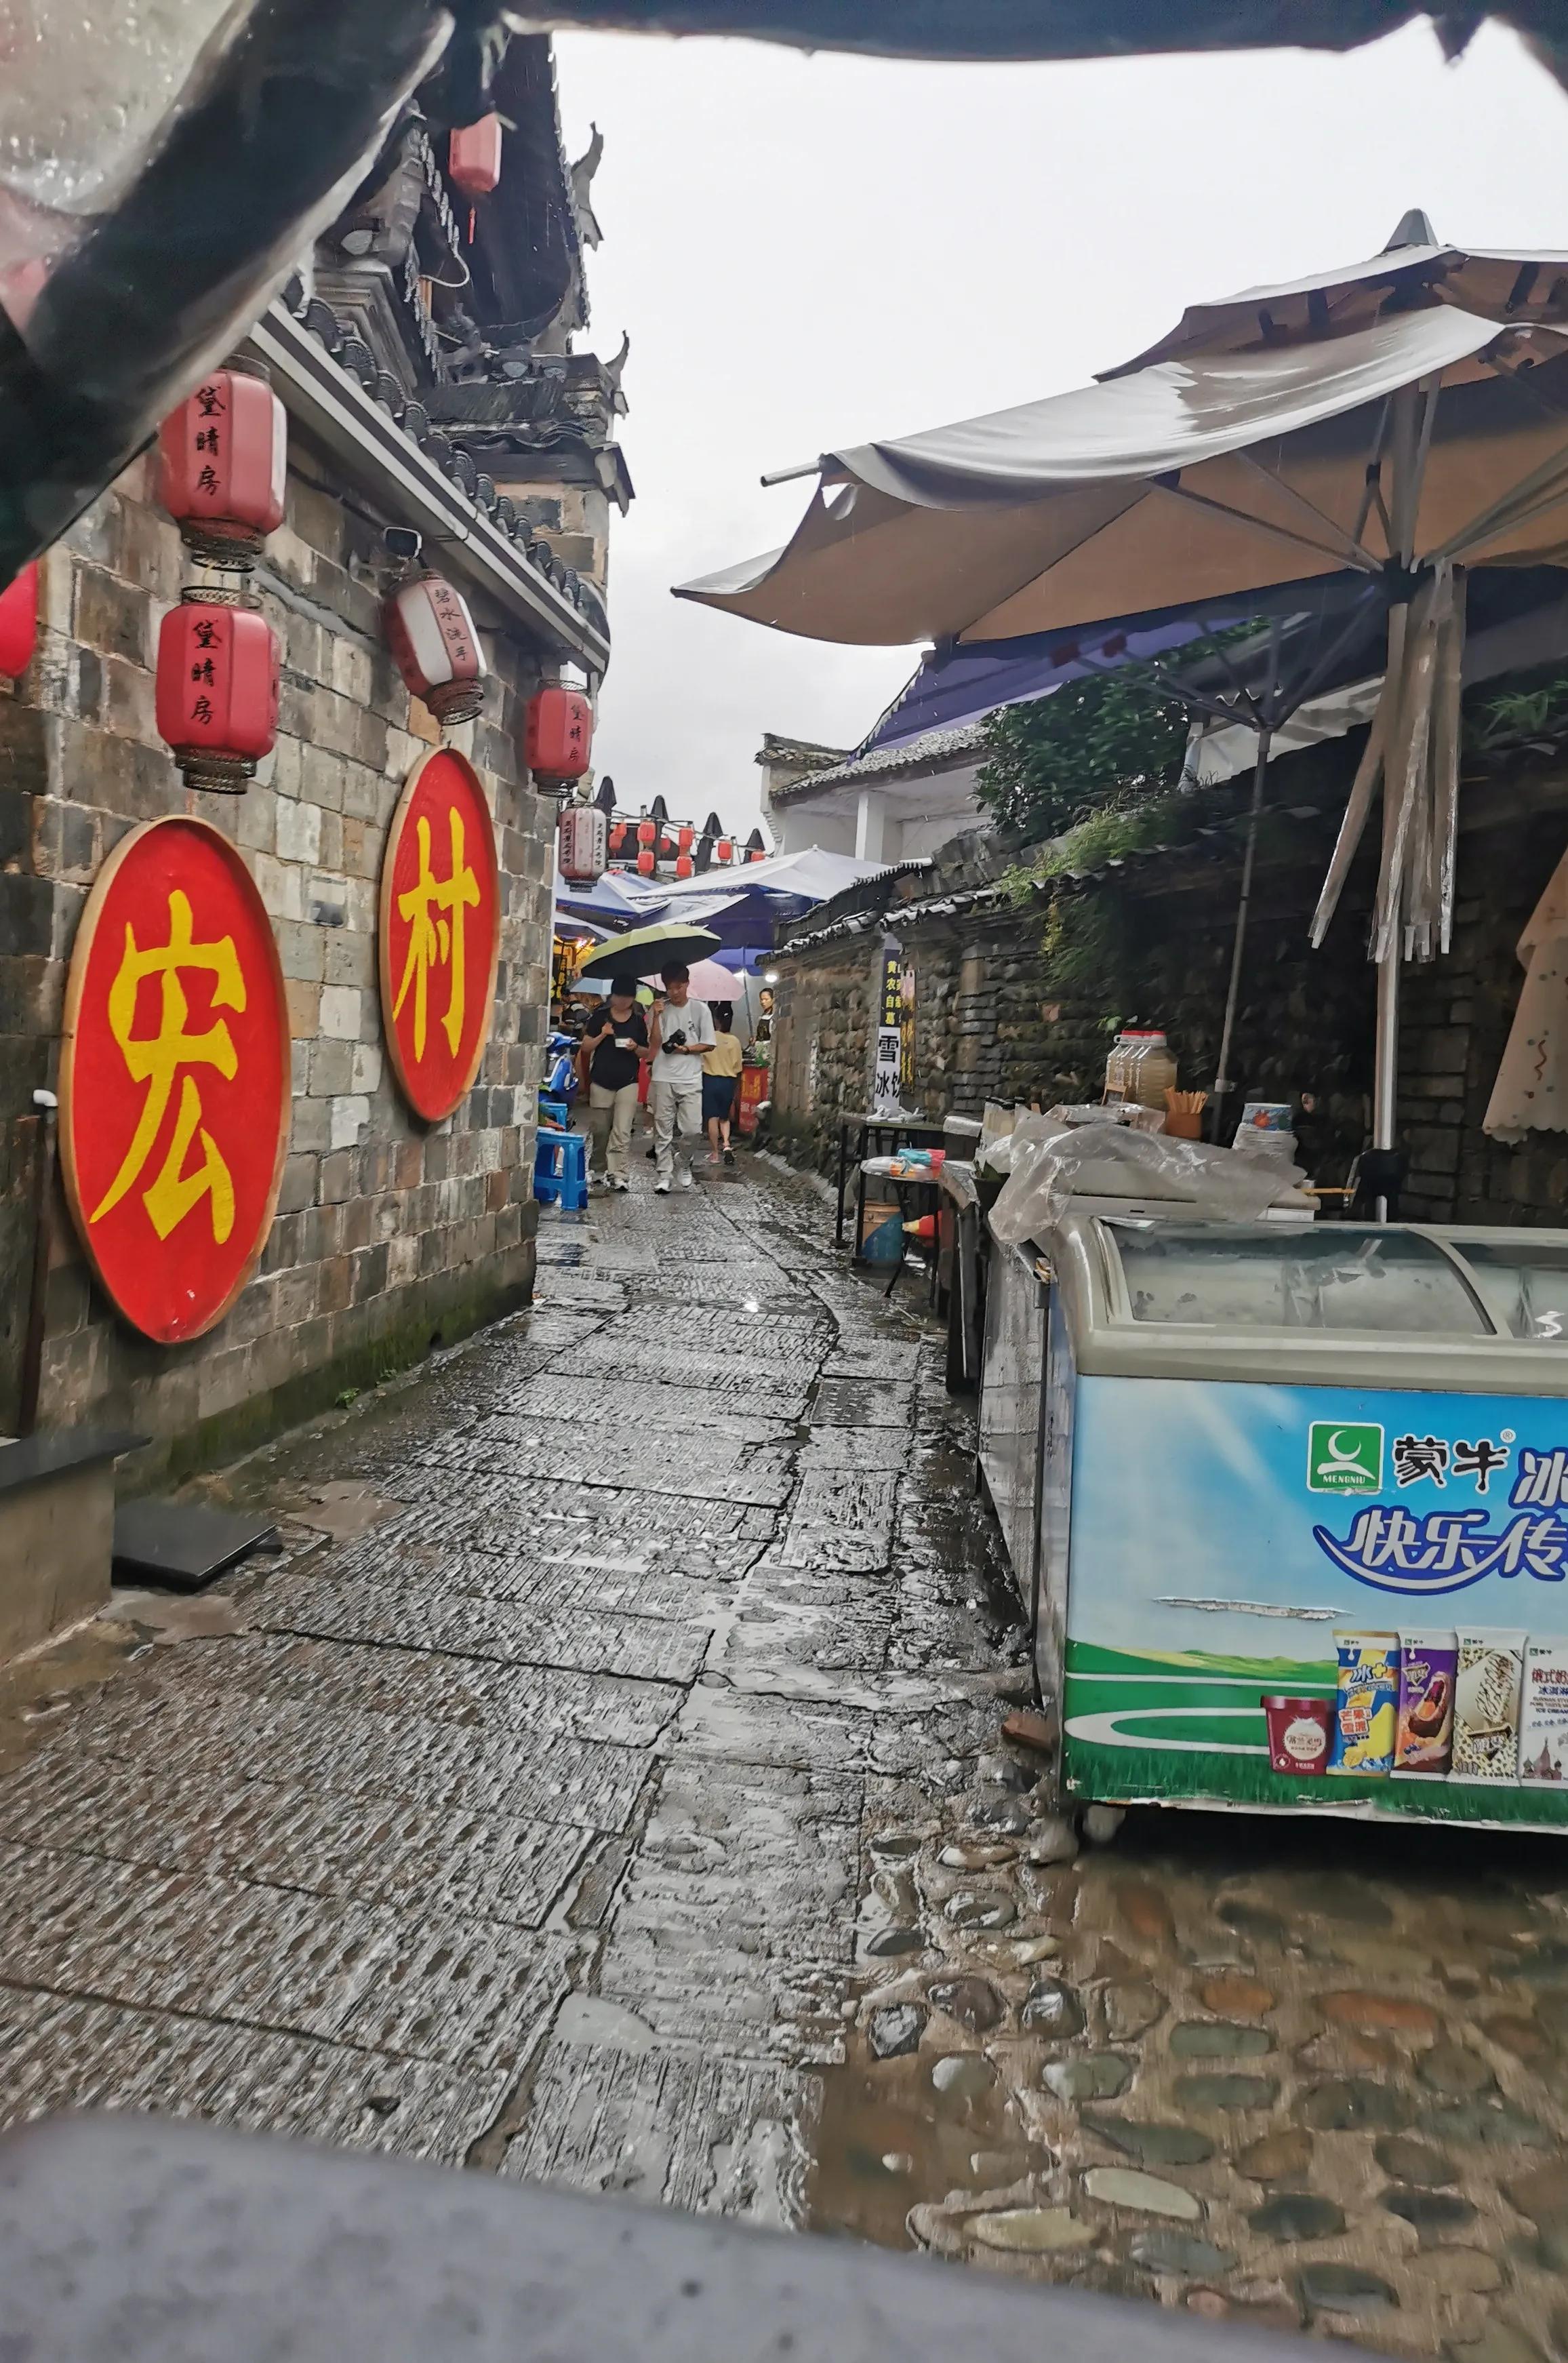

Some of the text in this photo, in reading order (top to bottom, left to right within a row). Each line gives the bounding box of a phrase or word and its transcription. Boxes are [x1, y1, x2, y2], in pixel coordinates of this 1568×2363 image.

[392, 807, 480, 1062] 村
[90, 890, 247, 1244] 宏
[879, 1035, 899, 1063] 雪
[1323, 1474, 1366, 1484] MENGNIU
[1394, 1435, 1508, 1491] 蒙牛
[1512, 1452, 1568, 1507] 冰
[1342, 1509, 1567, 1576] 快乐传
